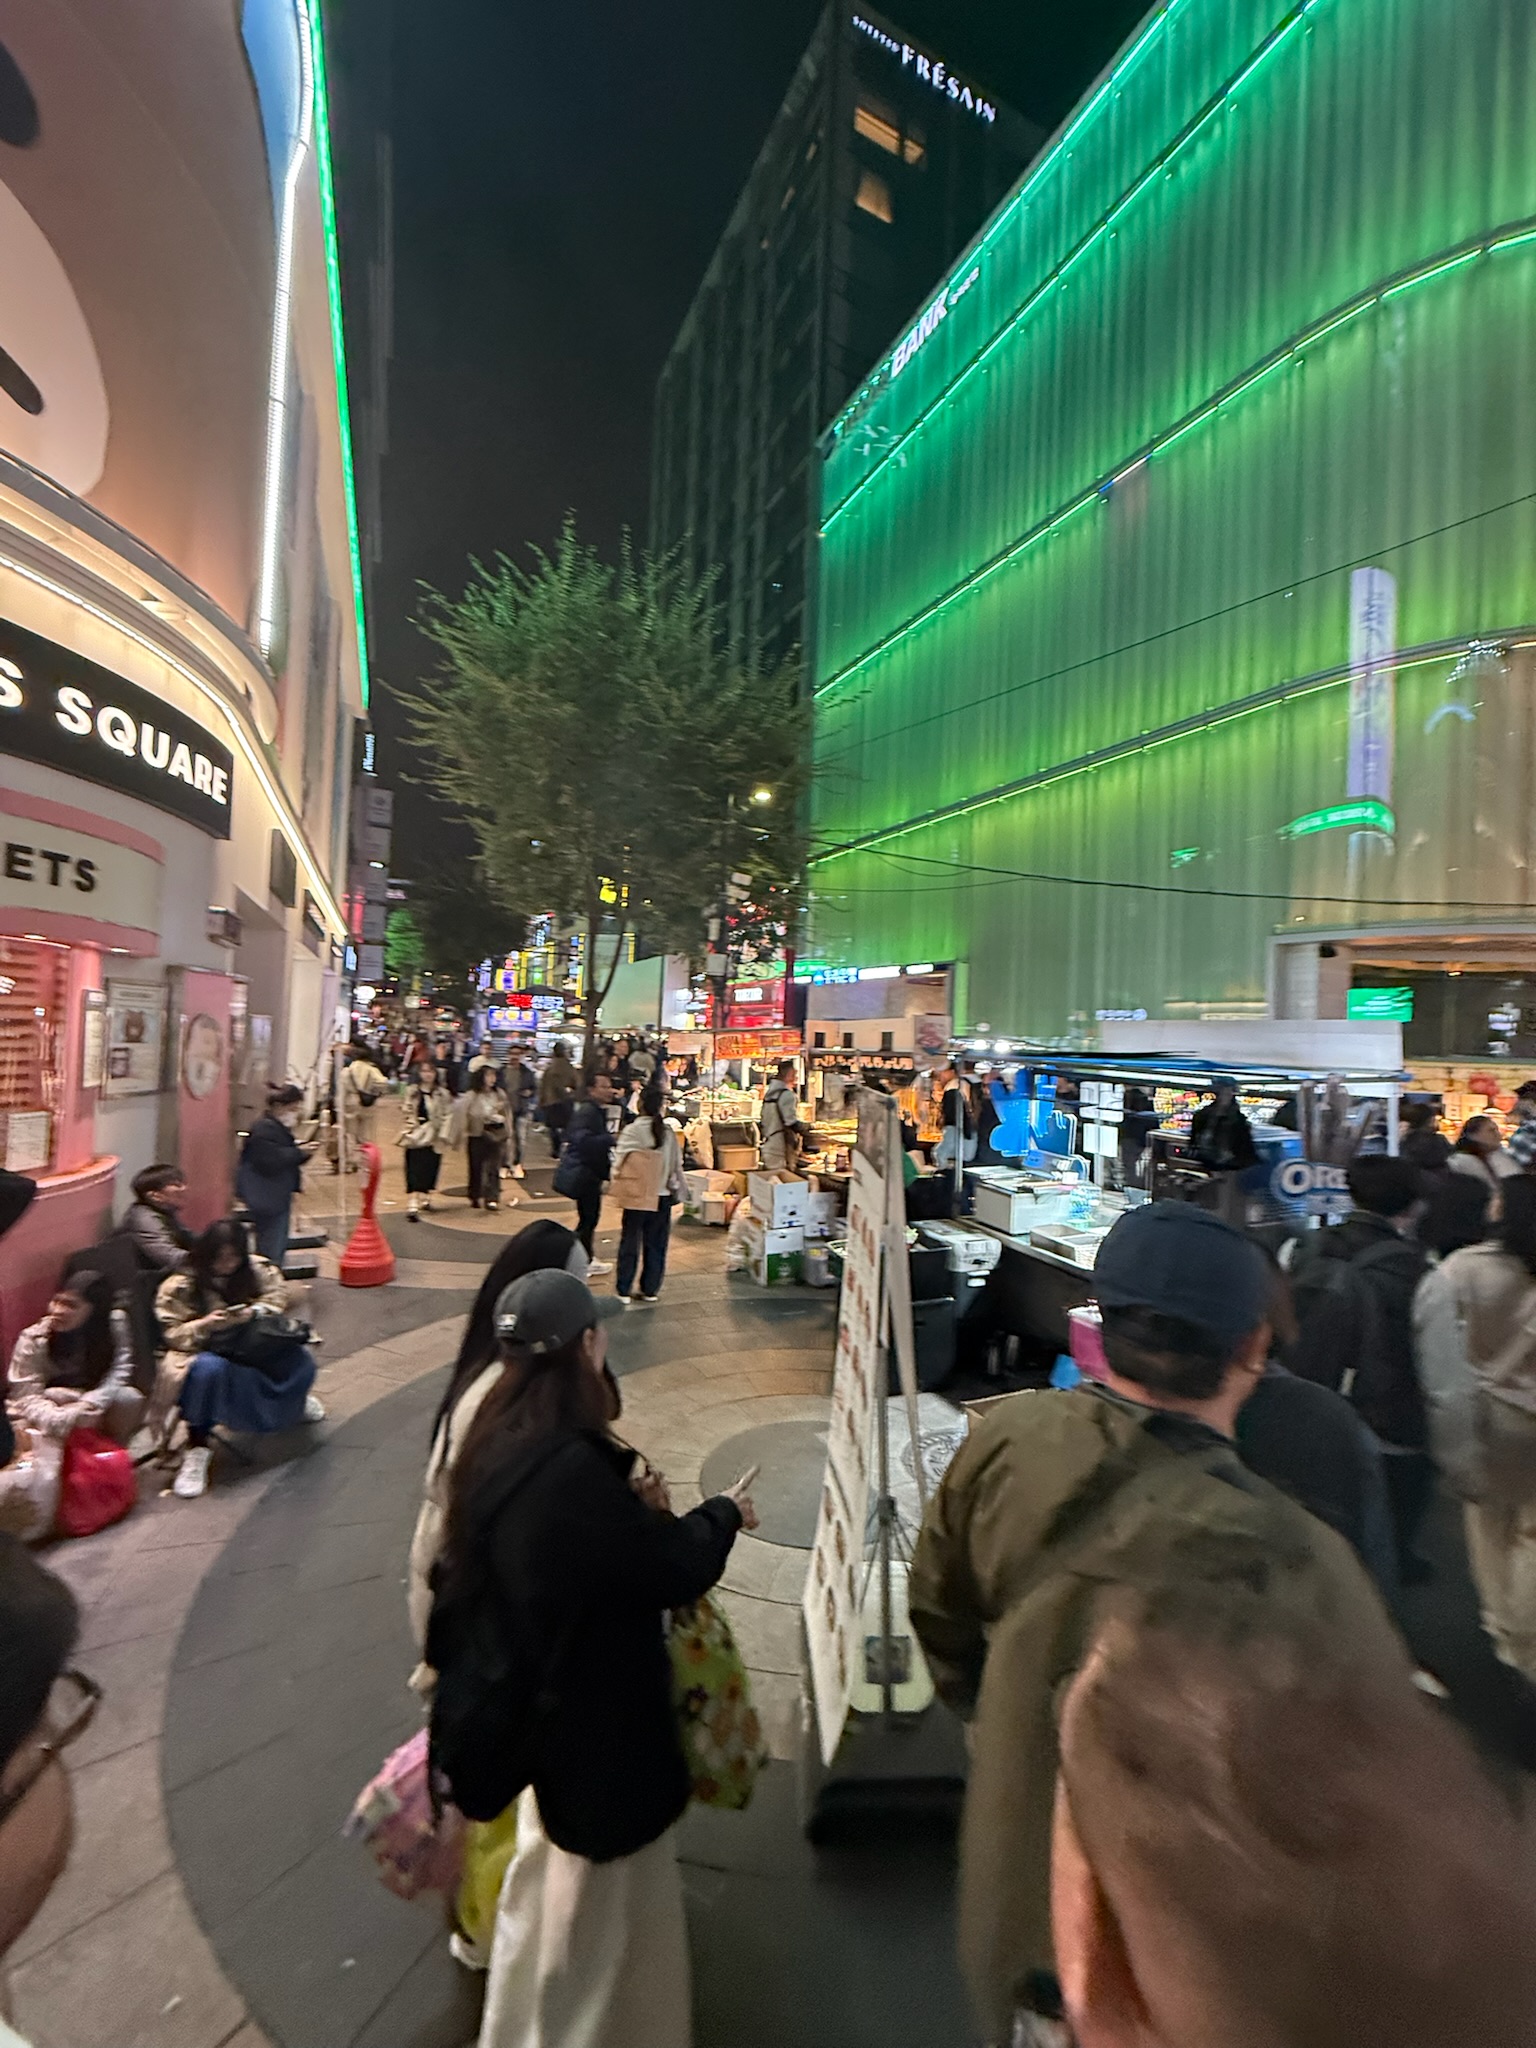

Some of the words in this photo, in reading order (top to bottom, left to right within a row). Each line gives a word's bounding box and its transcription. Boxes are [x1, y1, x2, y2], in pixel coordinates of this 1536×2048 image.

[891, 286, 950, 378] BANK
[55, 685, 228, 806] SQUARE
[4, 841, 98, 892] ETS
